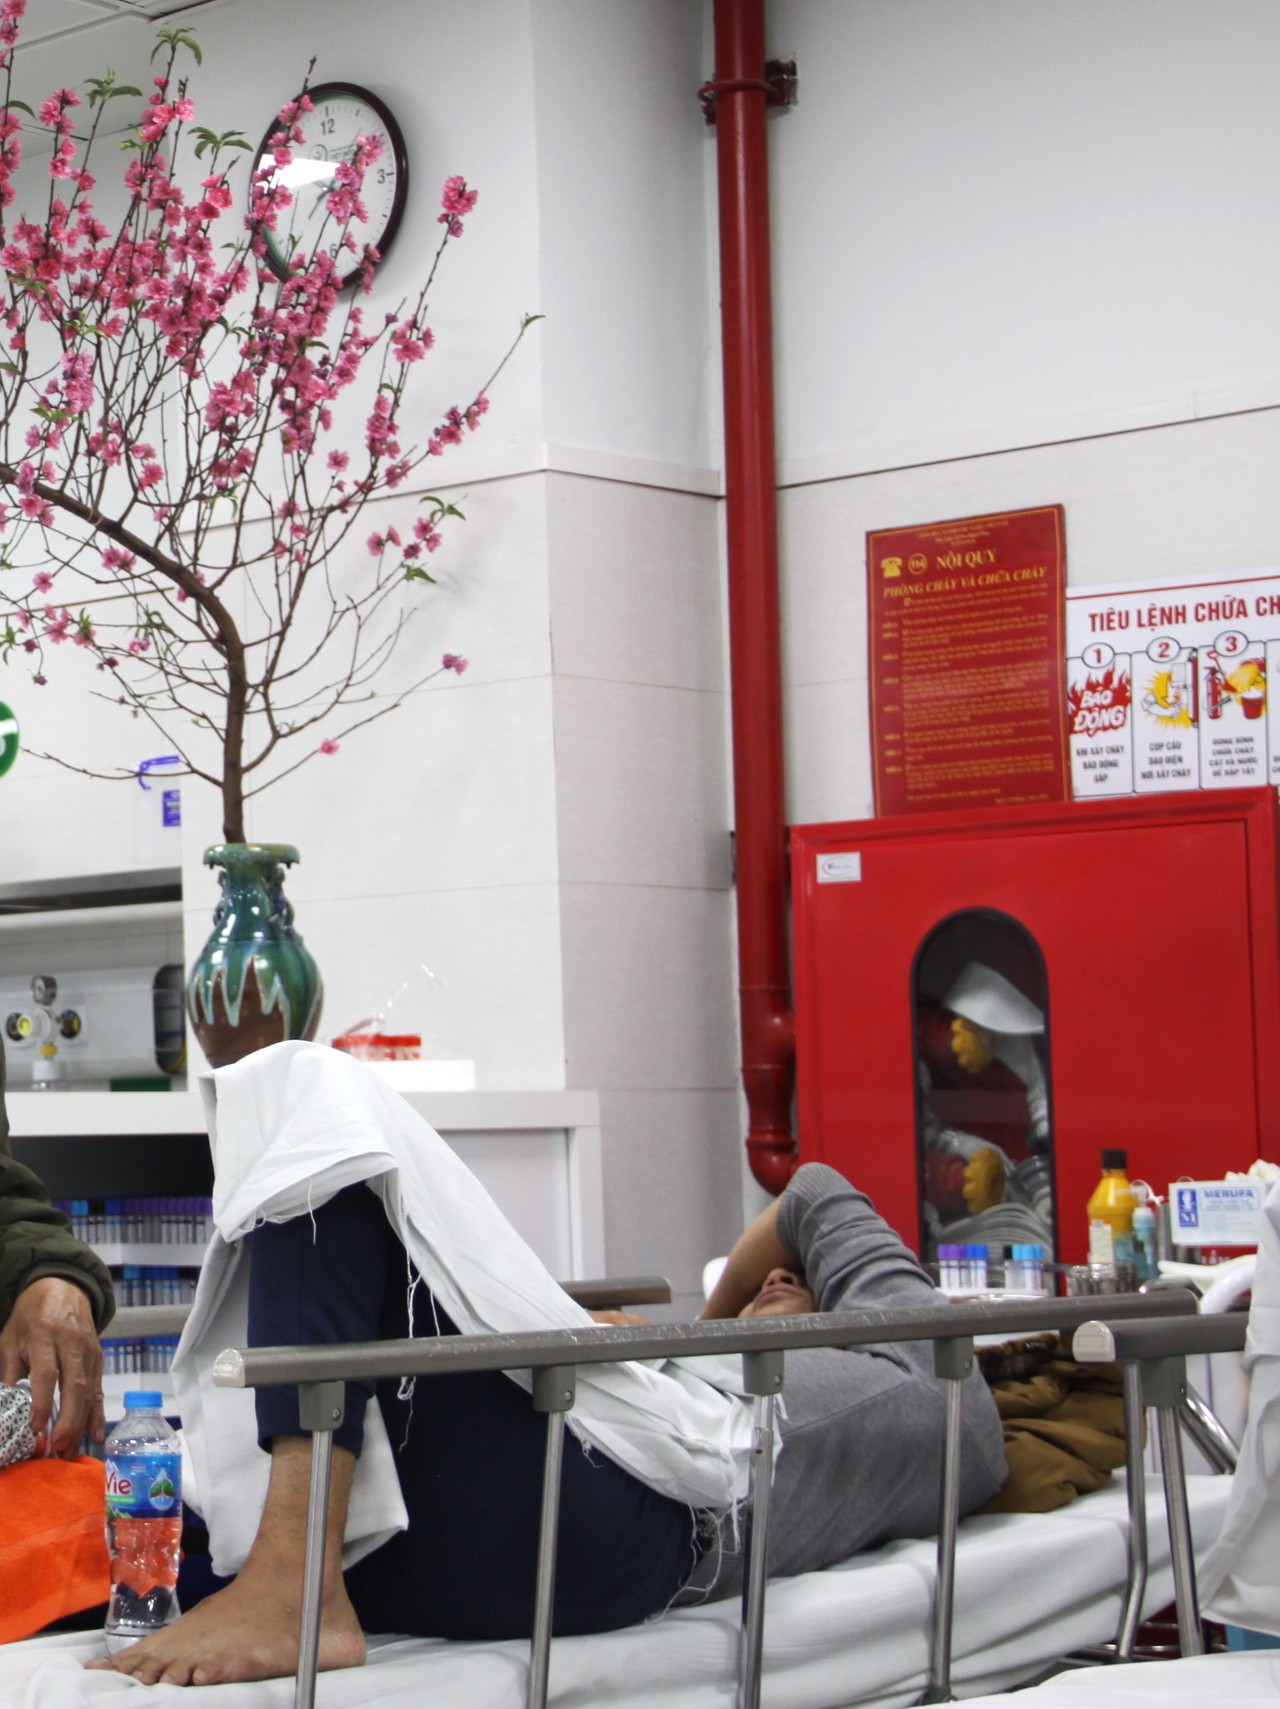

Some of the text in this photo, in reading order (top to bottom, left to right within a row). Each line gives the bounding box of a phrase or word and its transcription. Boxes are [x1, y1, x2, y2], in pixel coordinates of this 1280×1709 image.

[321, 118, 336, 136] 12
[377, 168, 386, 185] 3
[329, 243, 337, 258] 6
[936, 548, 998, 570] NỘI QUY
[883, 580, 924, 598] PHÒNG
[926, 576, 959, 593] CHÁY
[961, 572, 976, 588] VÀ
[978, 570, 1011, 587] CHỮA
[1013, 566, 1048, 582] CHÁY
[1088, 607, 1130, 632] TIÊU
[1136, 603, 1187, 632] LỆNH
[1194, 594, 1248, 622] CHỮA
[1157, 642, 1170, 658] 2
[1224, 636, 1238, 652] 3
[1093, 648, 1103, 664] 1
[1080, 686, 1113, 706] BÁO
[1074, 705, 1126, 735] ĐỘNG
[1204, 1189, 1254, 1198] MERUFA
[106, 1472, 132, 1495] Vie
